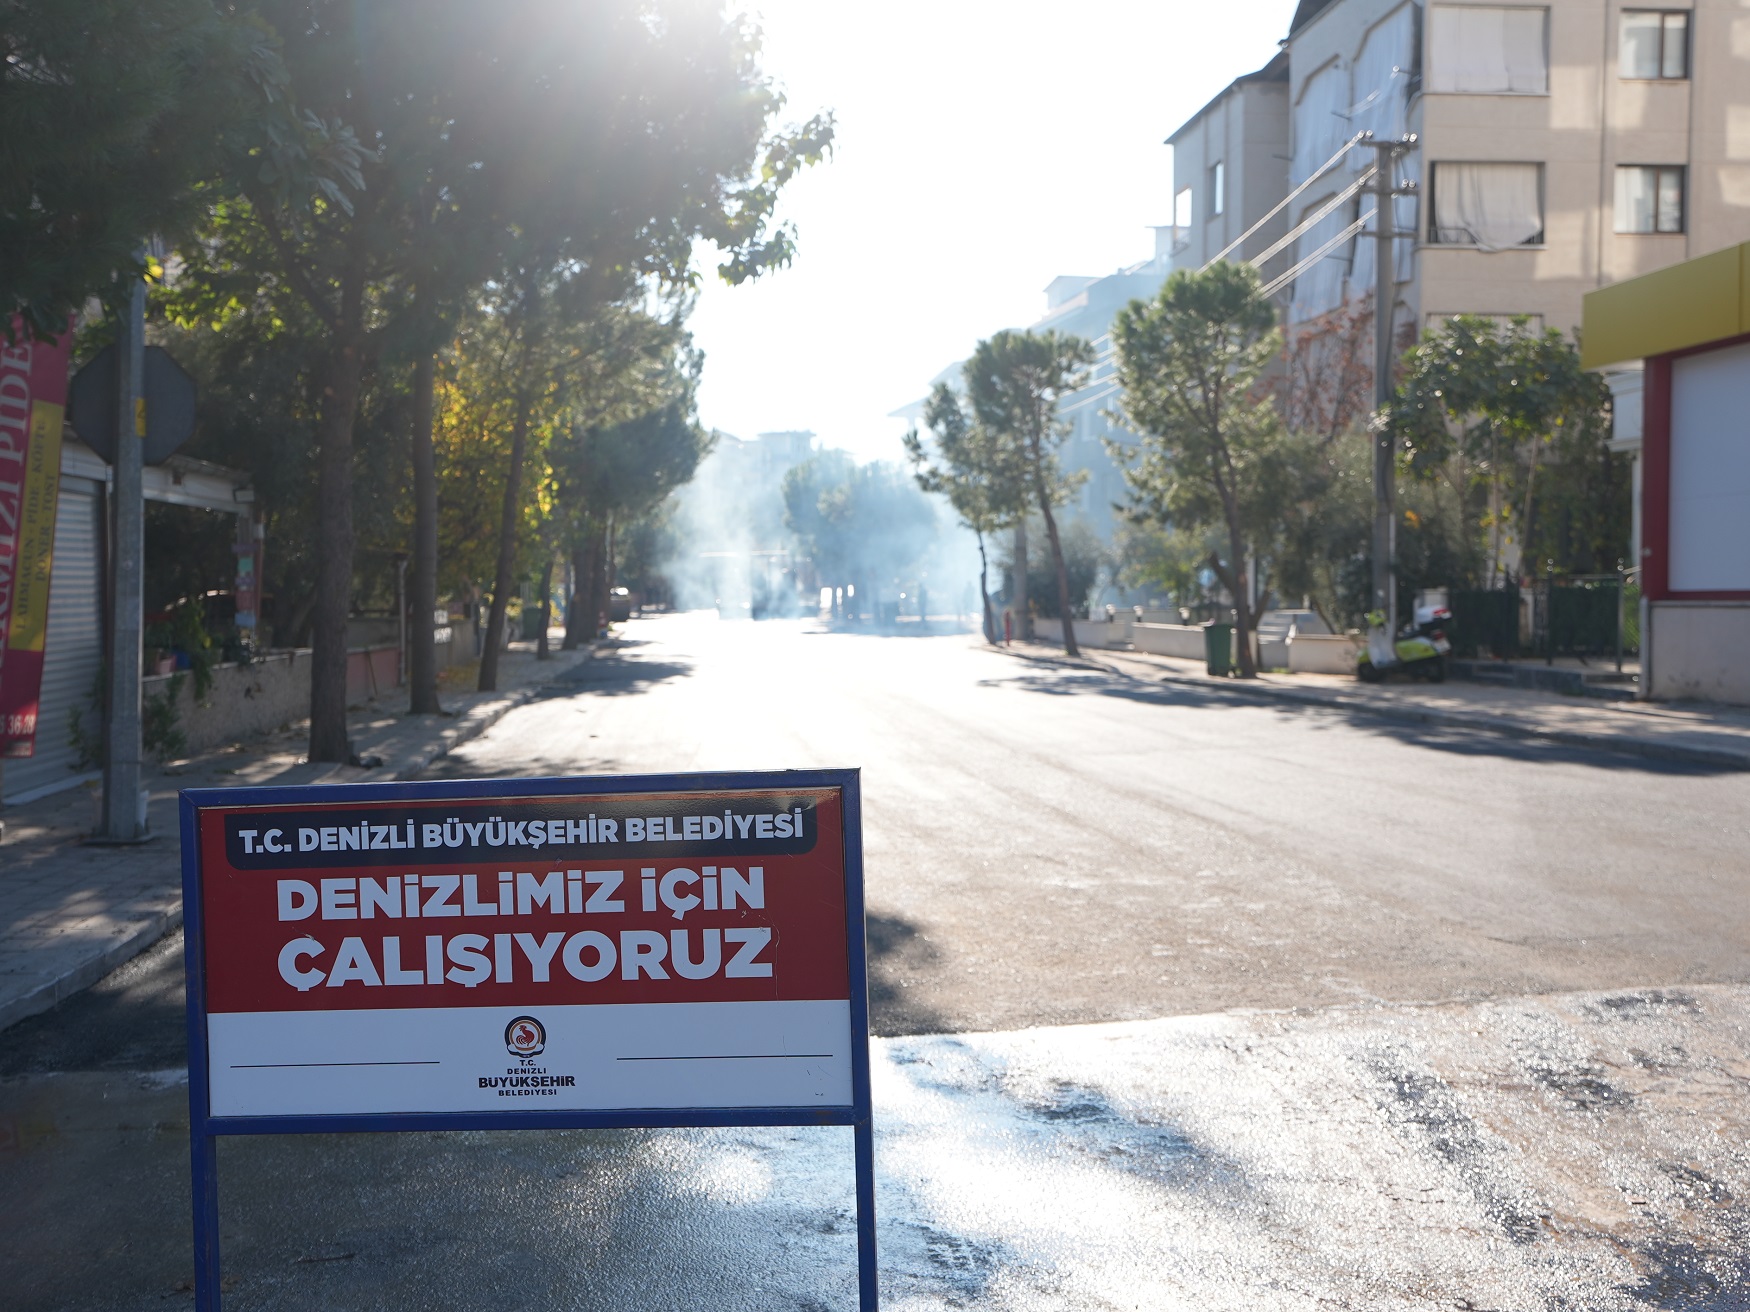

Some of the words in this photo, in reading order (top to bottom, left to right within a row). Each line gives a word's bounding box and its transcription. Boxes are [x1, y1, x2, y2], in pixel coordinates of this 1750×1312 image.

[42, 471, 56, 514] TOST
[238, 828, 292, 854] T.C.
[298, 818, 416, 852] DENİZLİ
[422, 813, 619, 850] BÜYÜKŞEHİR
[625, 807, 804, 842] BELEDİYESİ
[277, 926, 773, 992] ÇALIŞIYORUZ
[519, 1059, 536, 1067] T.C.
